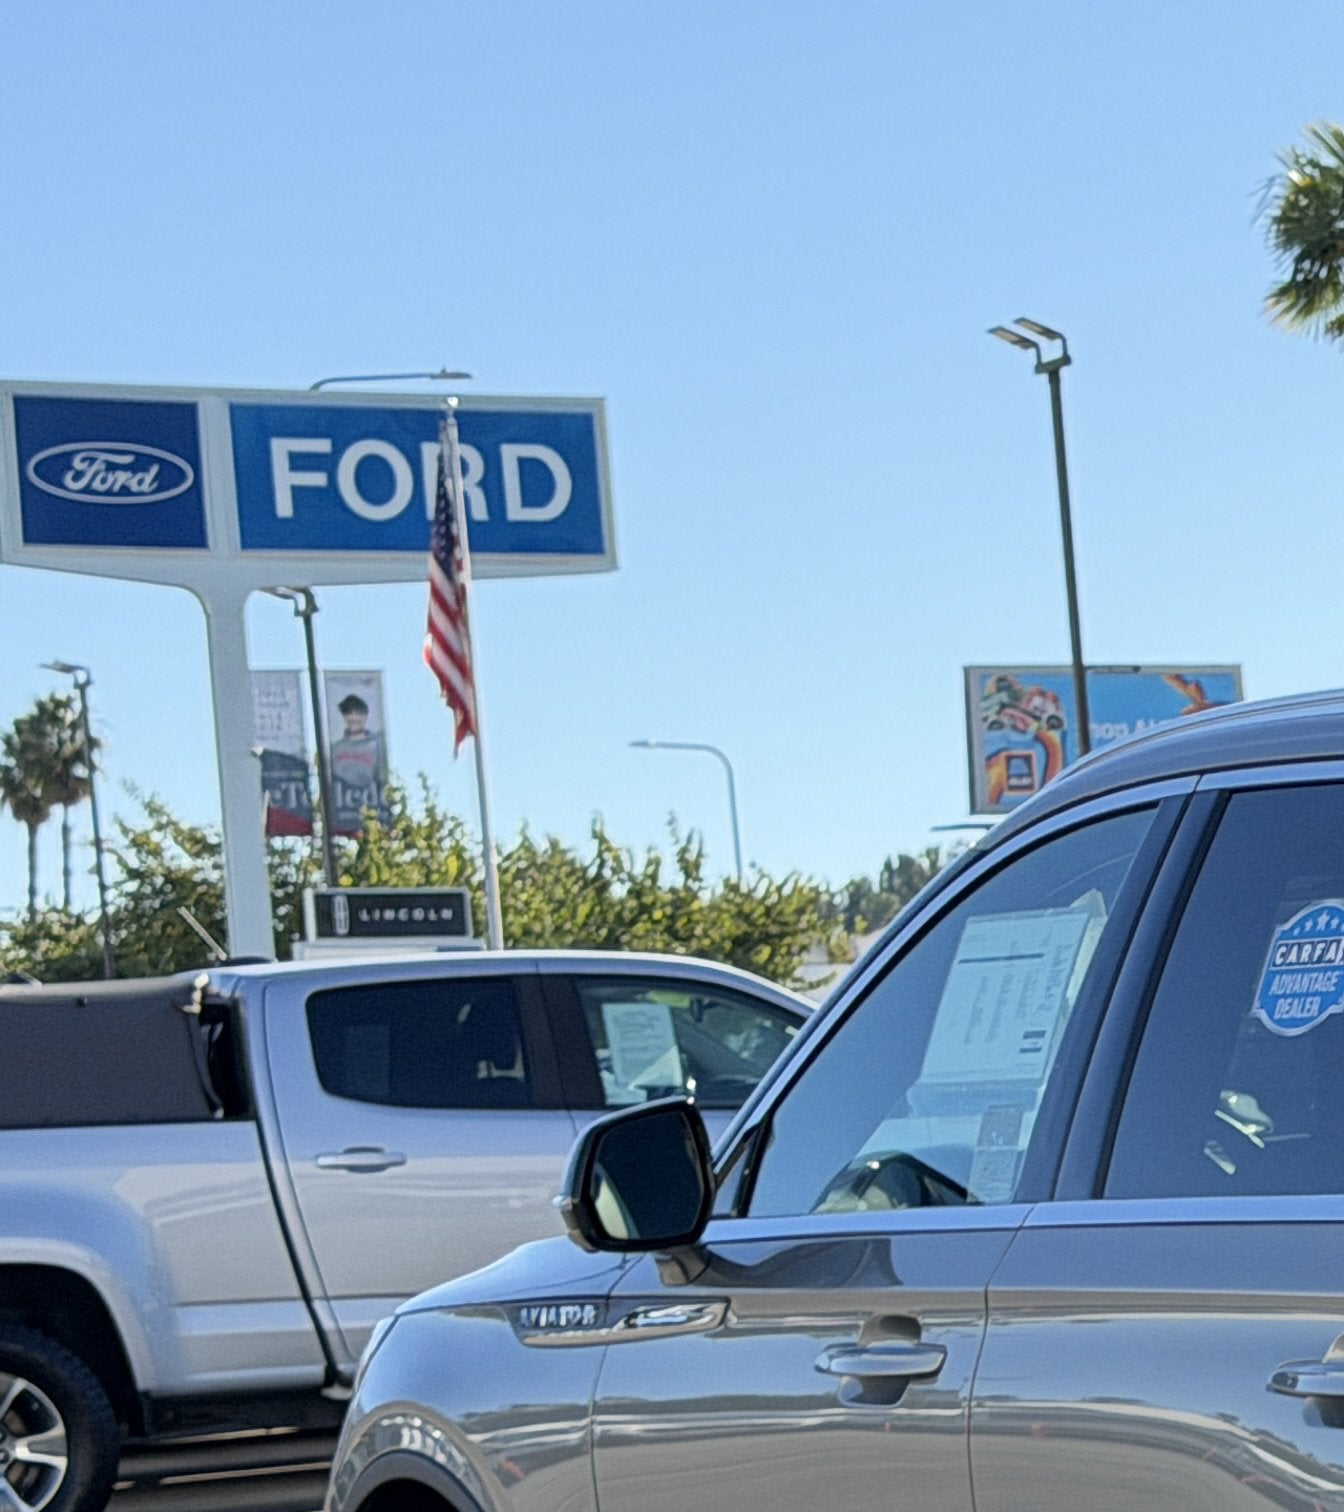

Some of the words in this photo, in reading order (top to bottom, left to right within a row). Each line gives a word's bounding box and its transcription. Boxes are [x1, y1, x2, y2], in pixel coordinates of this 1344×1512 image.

[63, 450, 160, 493] Ford
[270, 437, 572, 522] FORD
[358, 907, 453, 922] LINCOLN
[1270, 972, 1339, 995] ADVANTAGE
[1275, 997, 1321, 1019] DEALER
[520, 1304, 597, 1328] AVIATOR
